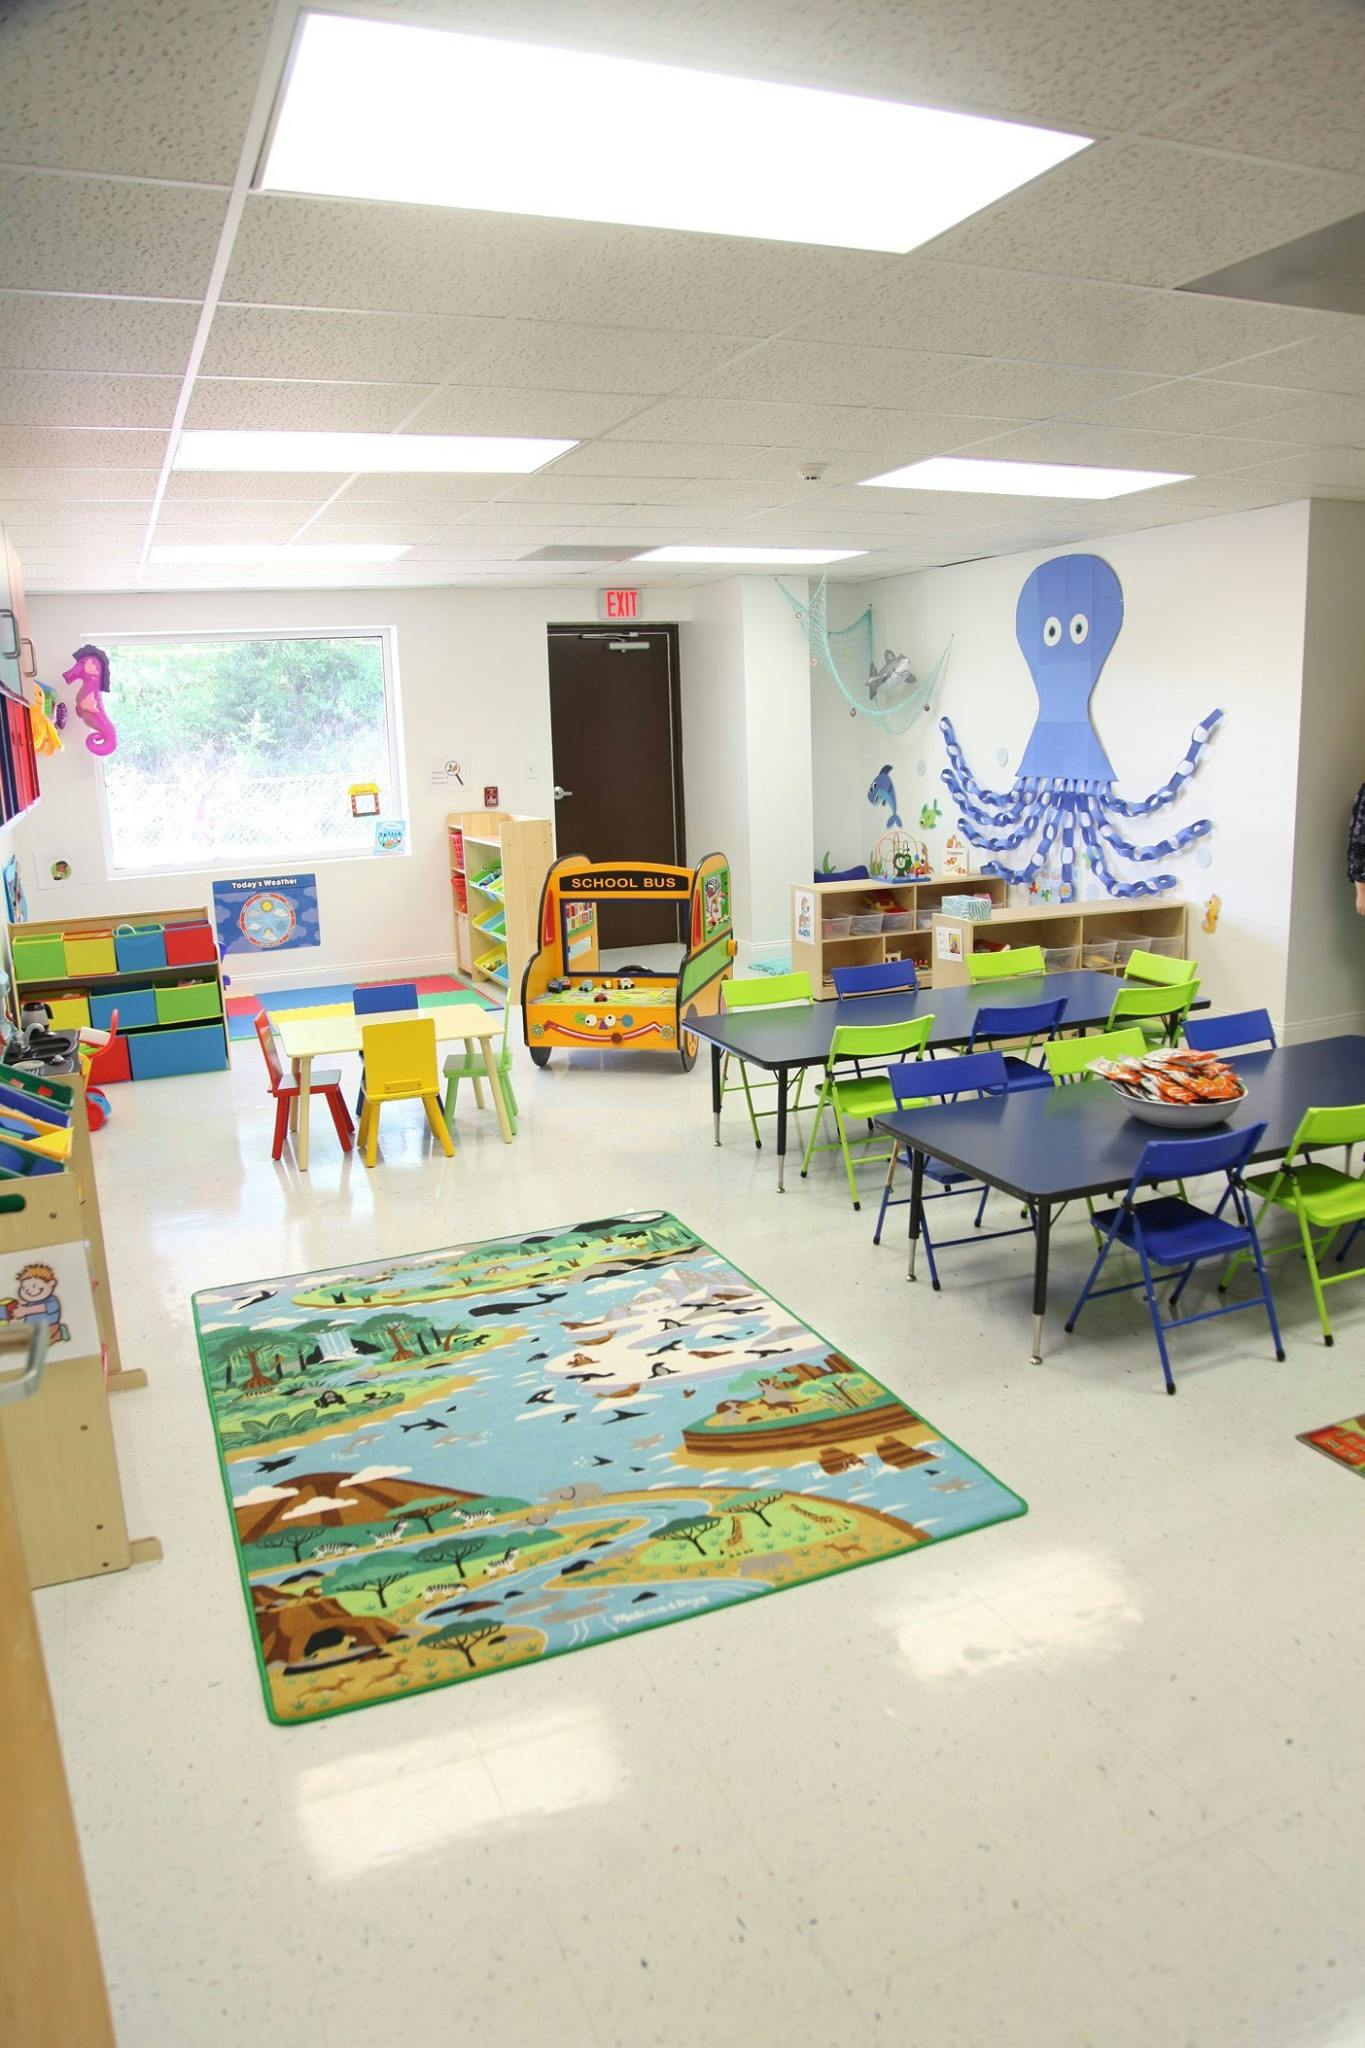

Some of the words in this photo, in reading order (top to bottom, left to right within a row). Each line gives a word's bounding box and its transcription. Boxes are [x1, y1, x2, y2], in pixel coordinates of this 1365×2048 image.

[607, 591, 637, 617] EXIT
[232, 881, 262, 889] Today's
[263, 878, 297, 887] Weather
[571, 878, 639, 889] SCHOOL
[643, 877, 677, 888] BUS
